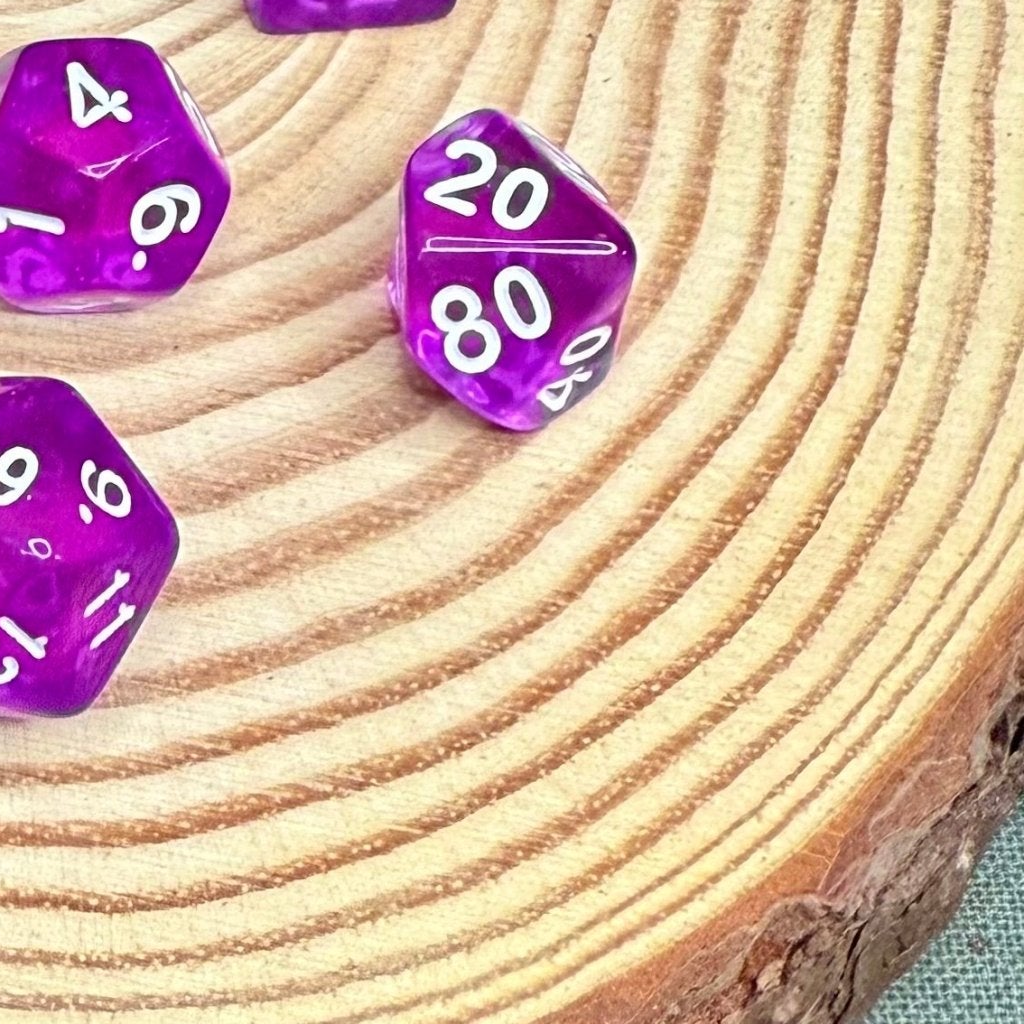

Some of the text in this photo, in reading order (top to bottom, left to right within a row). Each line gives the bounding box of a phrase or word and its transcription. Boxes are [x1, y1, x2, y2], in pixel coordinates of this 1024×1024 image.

[65, 60, 133, 129] 4
[423, 138, 550, 231] 20
[430, 265, 552, 375] 80
[536, 324, 613, 412] 40
[82, 568, 137, 652] 11
